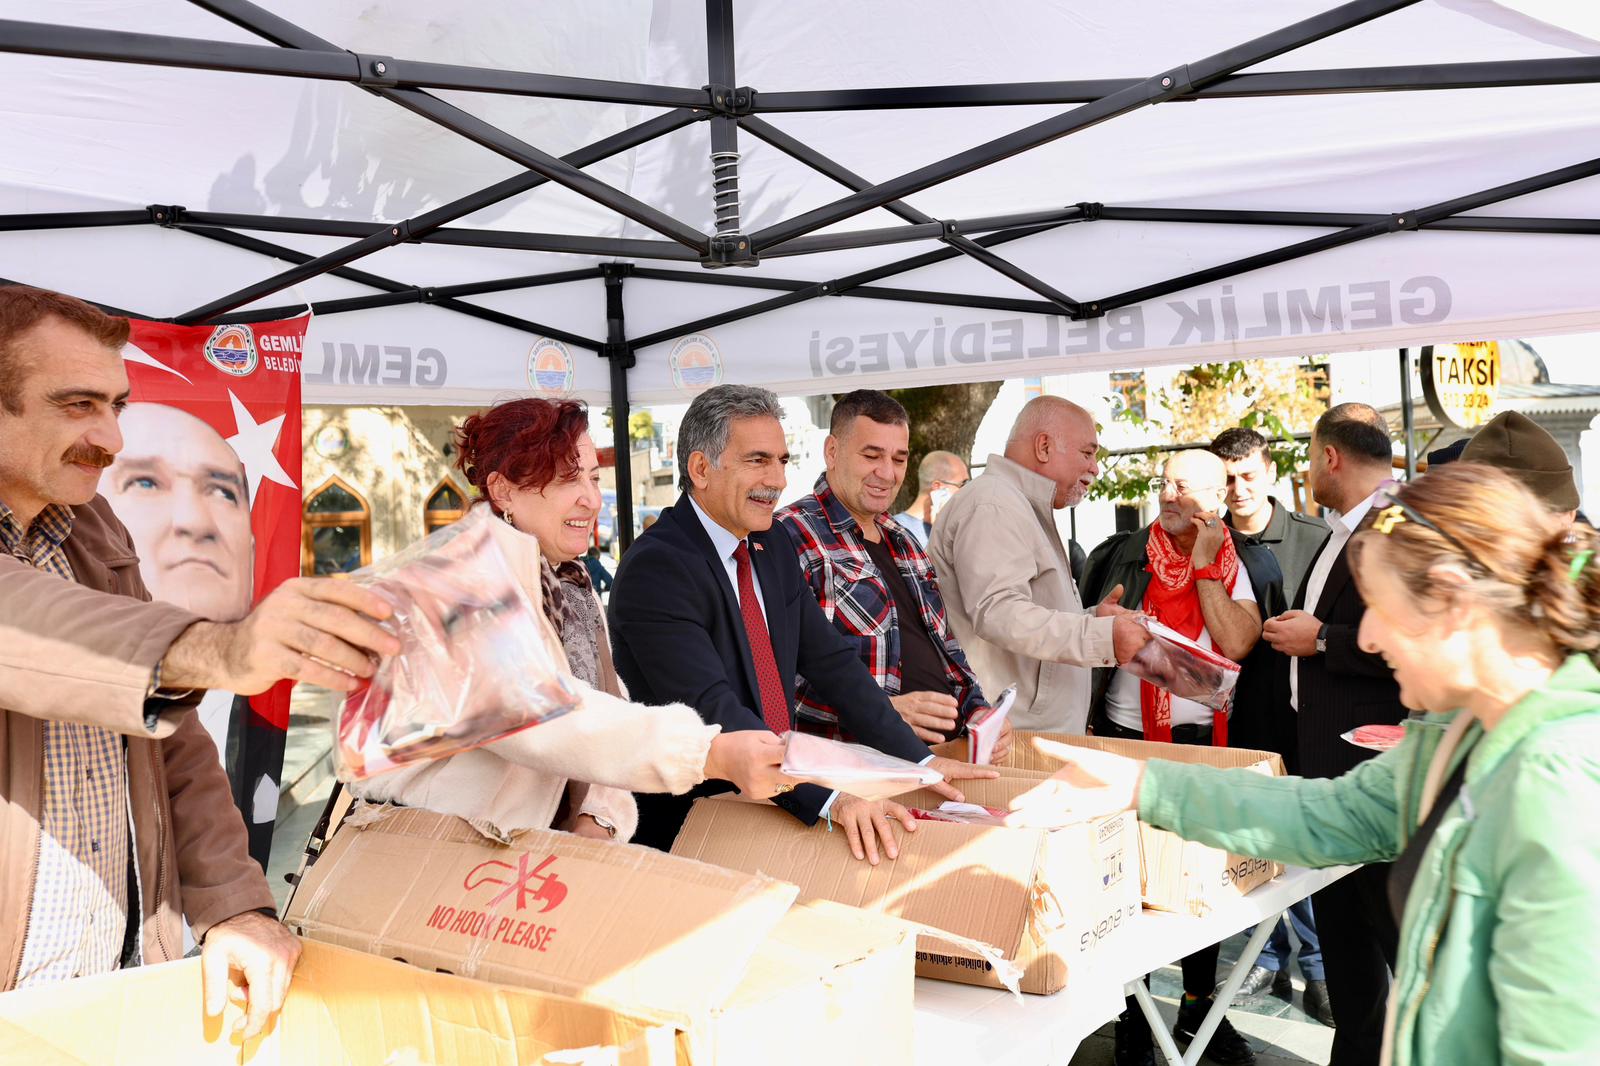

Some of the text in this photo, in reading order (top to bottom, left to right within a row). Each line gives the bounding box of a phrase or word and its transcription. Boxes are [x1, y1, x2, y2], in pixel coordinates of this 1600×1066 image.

[259, 331, 305, 353] GEMLİ
[1436, 351, 1494, 386] TAKSİ
[426, 904, 557, 952] NO HOOK PLEASE
[915, 951, 928, 961] ola
